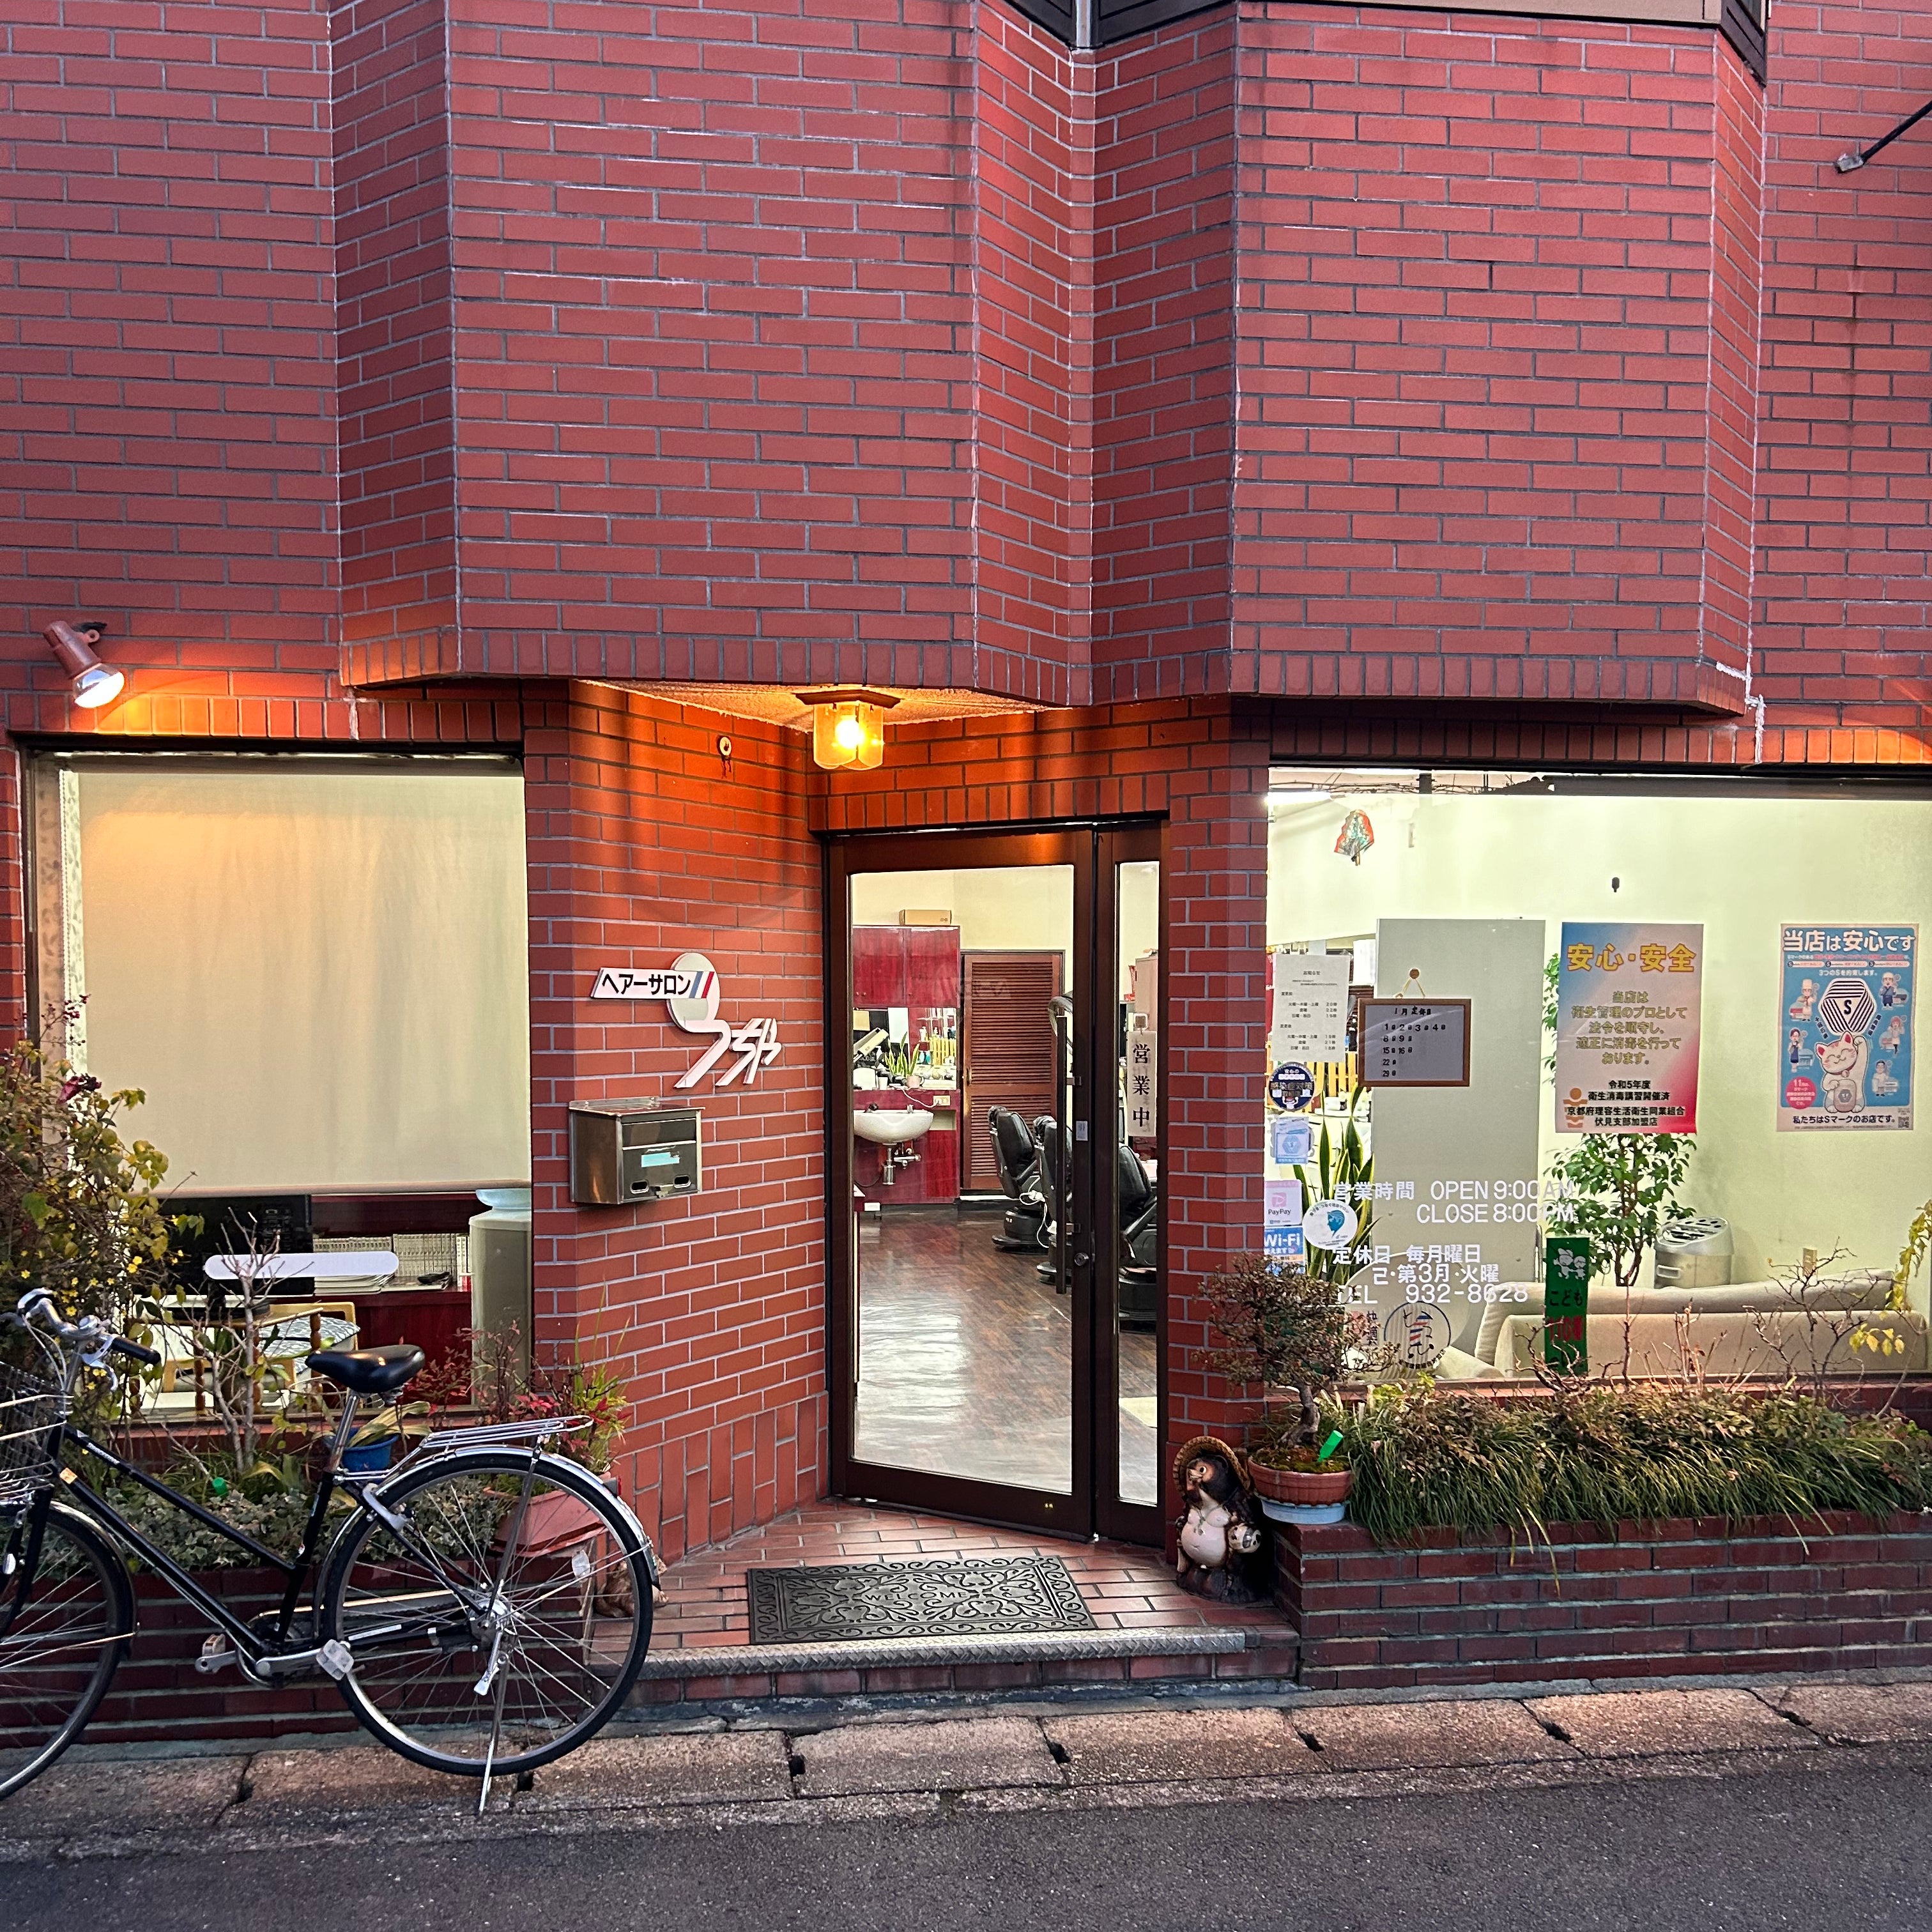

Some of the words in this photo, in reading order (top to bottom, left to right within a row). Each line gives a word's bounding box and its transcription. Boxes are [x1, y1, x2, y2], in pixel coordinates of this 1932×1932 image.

[1783, 930, 1915, 952] 当店は安心です
[1567, 942, 1697, 972] 安心・安全
[602, 974, 691, 995] ヘアーサロン
[1612, 991, 1648, 1003] 当店は
[1572, 1006, 1688, 1019] 衛生管理のプロとして
[1844, 999, 1851, 1015] S
[1589, 1021, 1664, 1034] 法令を順守し、
[1576, 1036, 1682, 1050] 適正に消毒を行って
[1602, 1052, 1650, 1064] おります。
[1133, 1043, 1151, 1127] 営業中
[1609, 1080, 1651, 1089] 令和5年度
[1567, 1106, 1685, 1116] 京都府理容生活衛生同業組合
[1595, 1117, 1658, 1126] 伏見支部加盟店
[1793, 1115, 1895, 1124] 私たちはSマークのお店です。
[1333, 1181, 1414, 1201] 営業時間
[1430, 1180, 1489, 1200] OPEN
[1416, 1203, 1489, 1223] CLOSE
[1264, 1233, 1300, 1246] Wi-Fi
[1333, 1245, 1390, 1264] 定休日
[1406, 1244, 1481, 1264] 毎月曜日
[1406, 1283, 1528, 1303] 932-8628
[1549, 1289, 1583, 1307] こども
[864, 1591, 967, 1601] WELCOME
